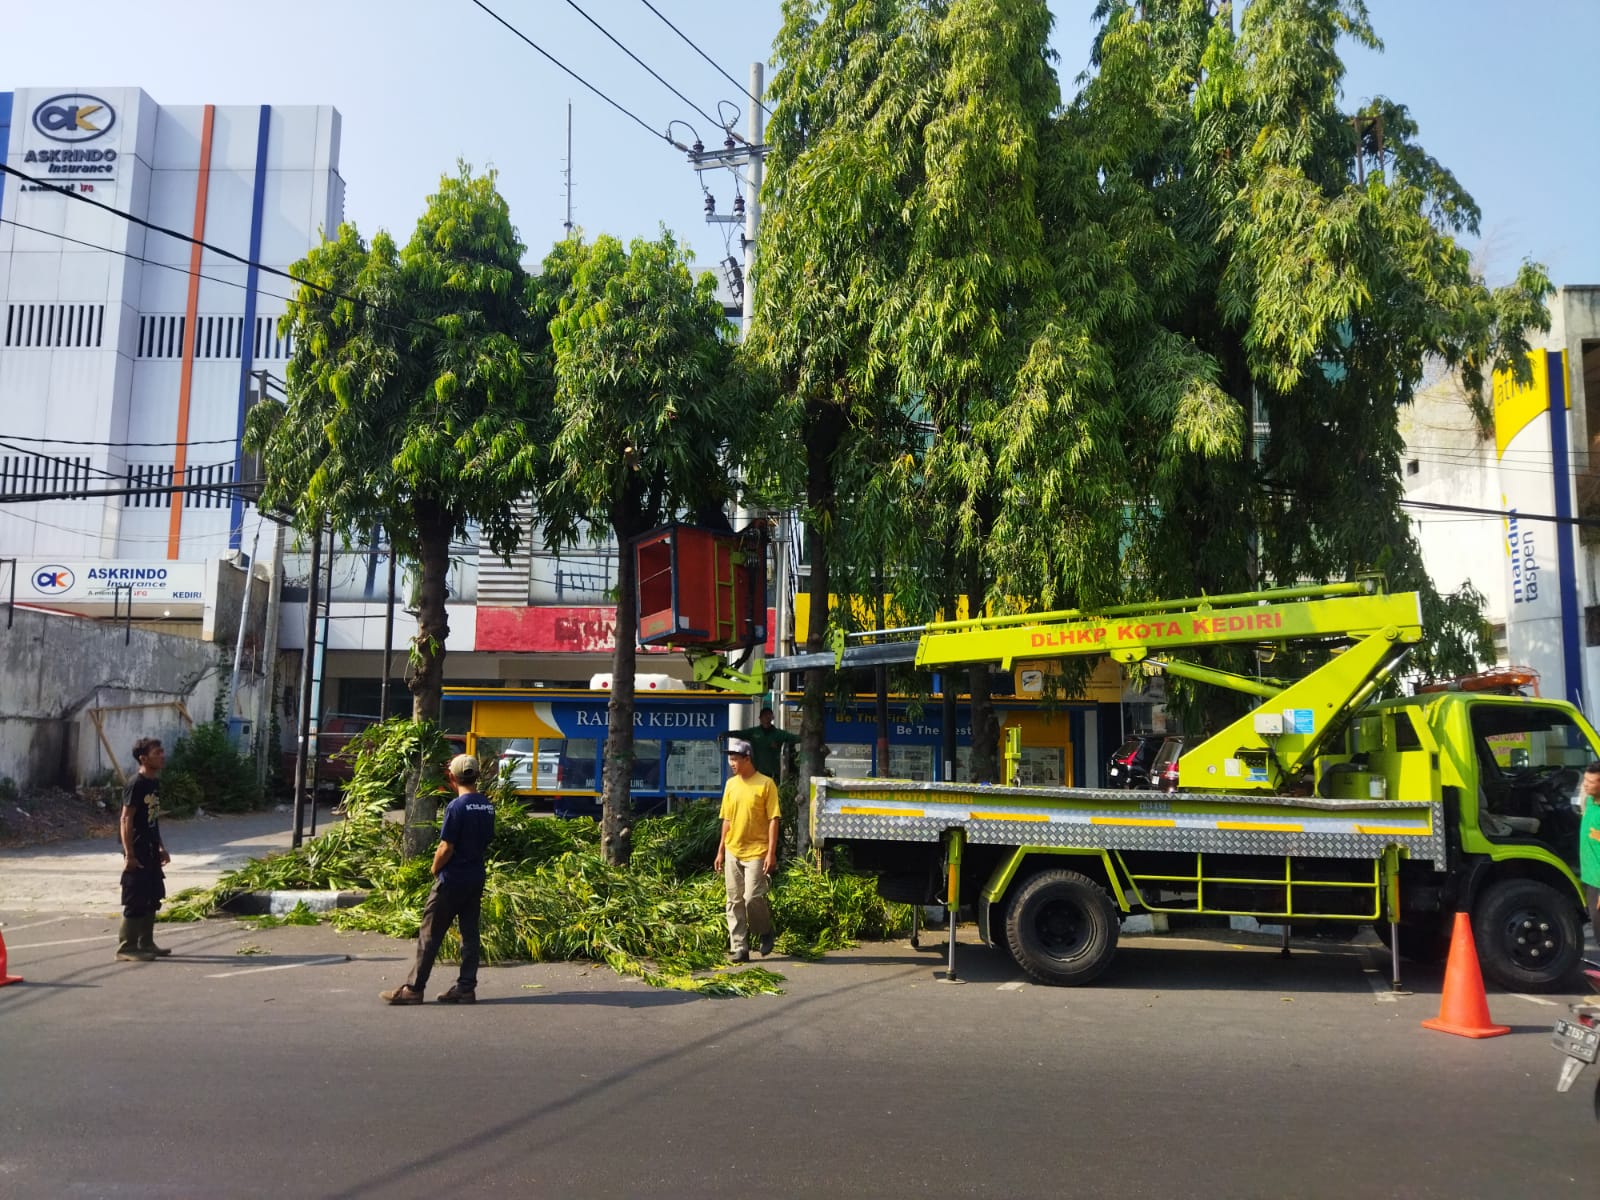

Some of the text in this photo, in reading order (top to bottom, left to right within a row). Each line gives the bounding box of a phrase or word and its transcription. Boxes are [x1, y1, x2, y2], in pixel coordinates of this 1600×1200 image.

[24, 149, 117, 163] ASKRINDO
[20, 184, 27, 192] A
[1522, 531, 1540, 603] taspen
[87, 568, 167, 580] ASKRINDO
[107, 580, 166, 588] Insurance
[172, 591, 202, 599] KEDIRI
[1031, 612, 1282, 648] DLHKP KOTA KEDIRI
[576, 710, 716, 728] RAR KEDIRI
[835, 713, 852, 722] Be
[857, 713, 878, 722] The
[896, 725, 912, 735] Be
[916, 725, 940, 735] The
[848, 792, 973, 804] DLHKP KOTA KEDIRI
